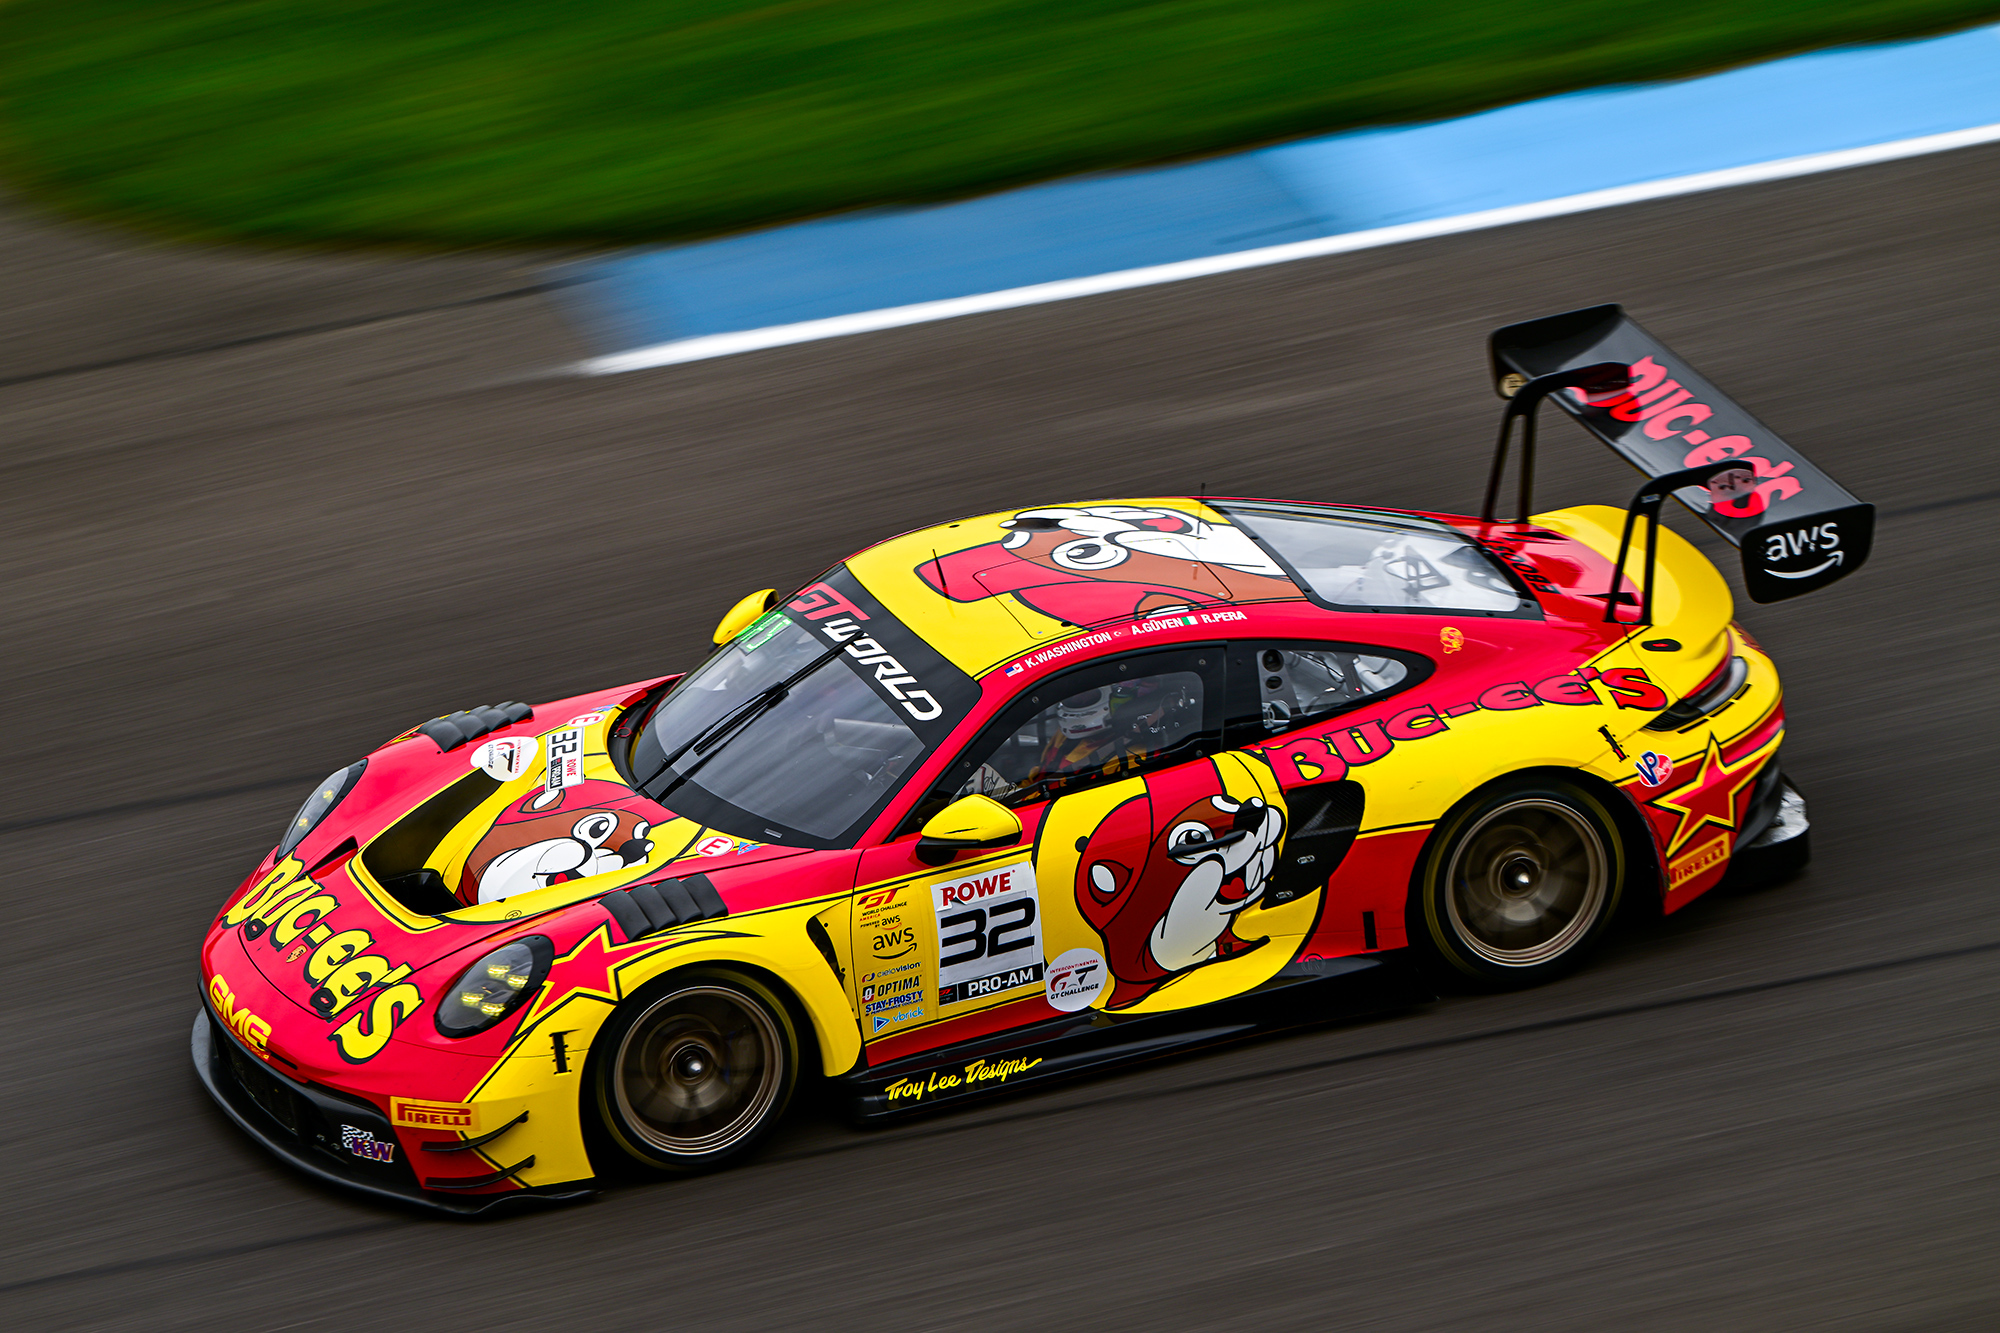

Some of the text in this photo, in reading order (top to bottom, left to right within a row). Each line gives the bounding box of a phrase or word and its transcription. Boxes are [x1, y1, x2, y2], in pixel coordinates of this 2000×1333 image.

[1765, 522, 1840, 562] aws
[786, 581, 943, 722] GT WORLD
[1023, 610, 1248, 669] K.WASHINGTON A.GÜVEN R.PERA
[551, 731, 577, 758] 32
[566, 758, 577, 777] ROWE
[1634, 750, 1664, 787] VP
[700, 837, 729, 855] E
[1668, 839, 1726, 885] PIRELLI
[857, 884, 910, 909] GT
[942, 871, 1012, 907] ROWE
[860, 913, 881, 922] AMERICA
[862, 901, 908, 916] WORLD CHALLENGE
[881, 914, 901, 926] aws
[873, 927, 915, 951] aws
[940, 896, 1036, 969] 32
[877, 961, 921, 978] cielovision
[1050, 959, 1099, 974] INTERCONTINENTAL
[878, 975, 920, 997] OPTIMA
[968, 967, 1034, 997] PRO-AM
[1050, 983, 1100, 1000] GT CHALLENGE
[865, 990, 924, 1013] STAY-FROSTY
[893, 1006, 924, 1022] vbrick
[885, 1056, 1043, 1101] Troy Lee Designs
[397, 1102, 472, 1127] PIRELLI
[352, 1136, 395, 1164] KW
